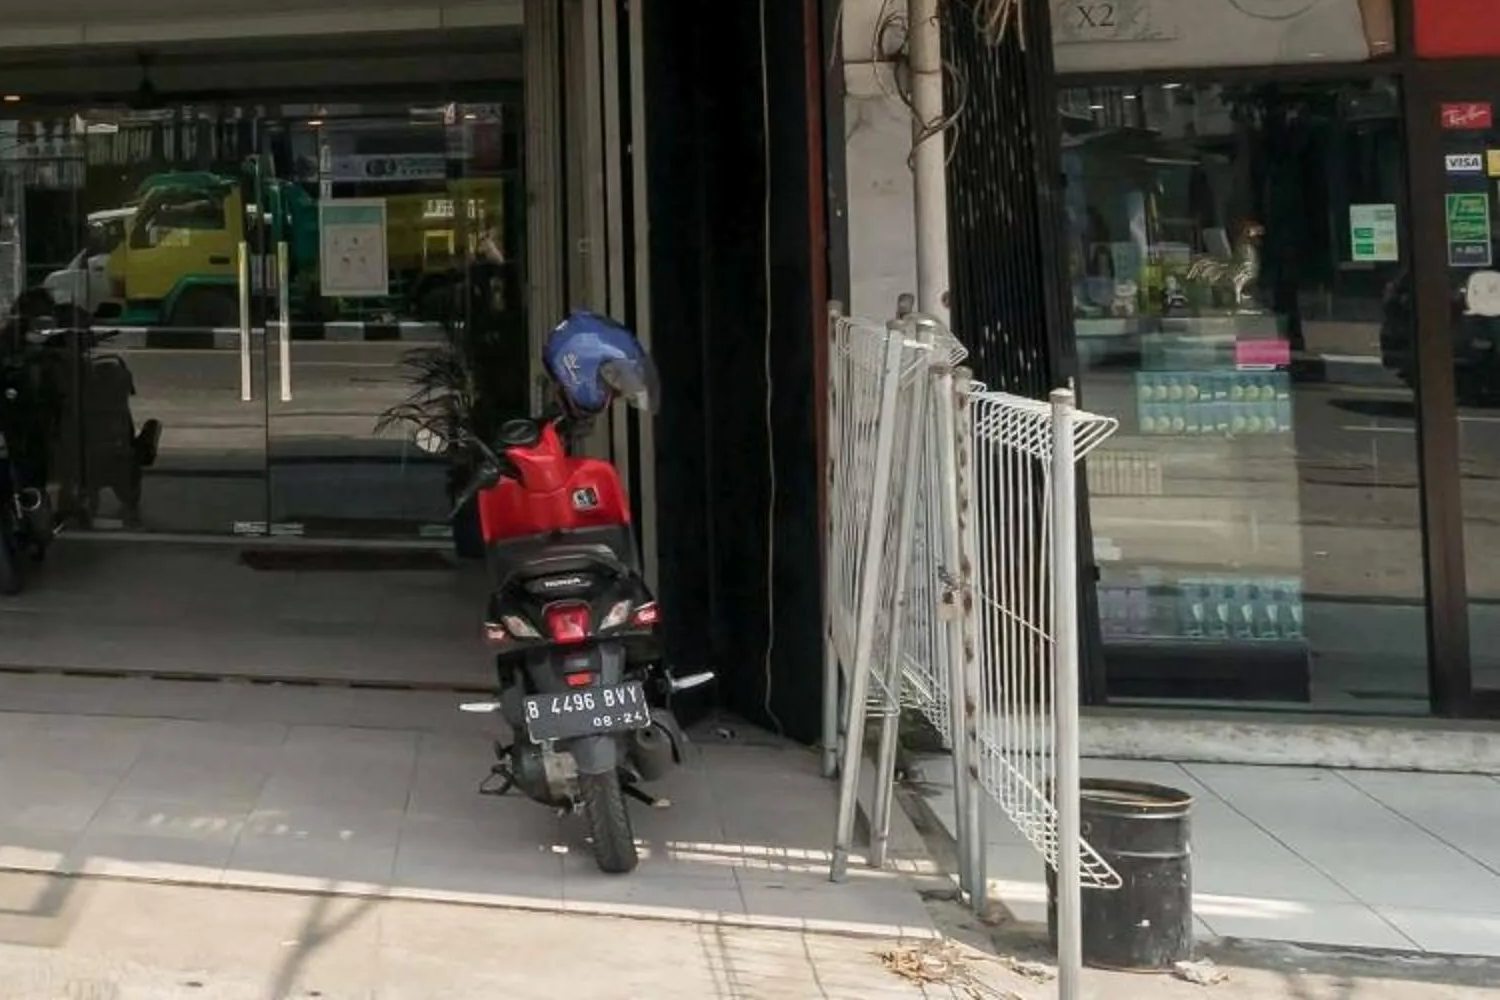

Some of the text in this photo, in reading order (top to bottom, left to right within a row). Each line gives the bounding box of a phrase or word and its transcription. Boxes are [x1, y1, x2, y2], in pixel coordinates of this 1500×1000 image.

[1449, 156, 1480, 168] VISA
[527, 685, 638, 719] B 4496 BVY
